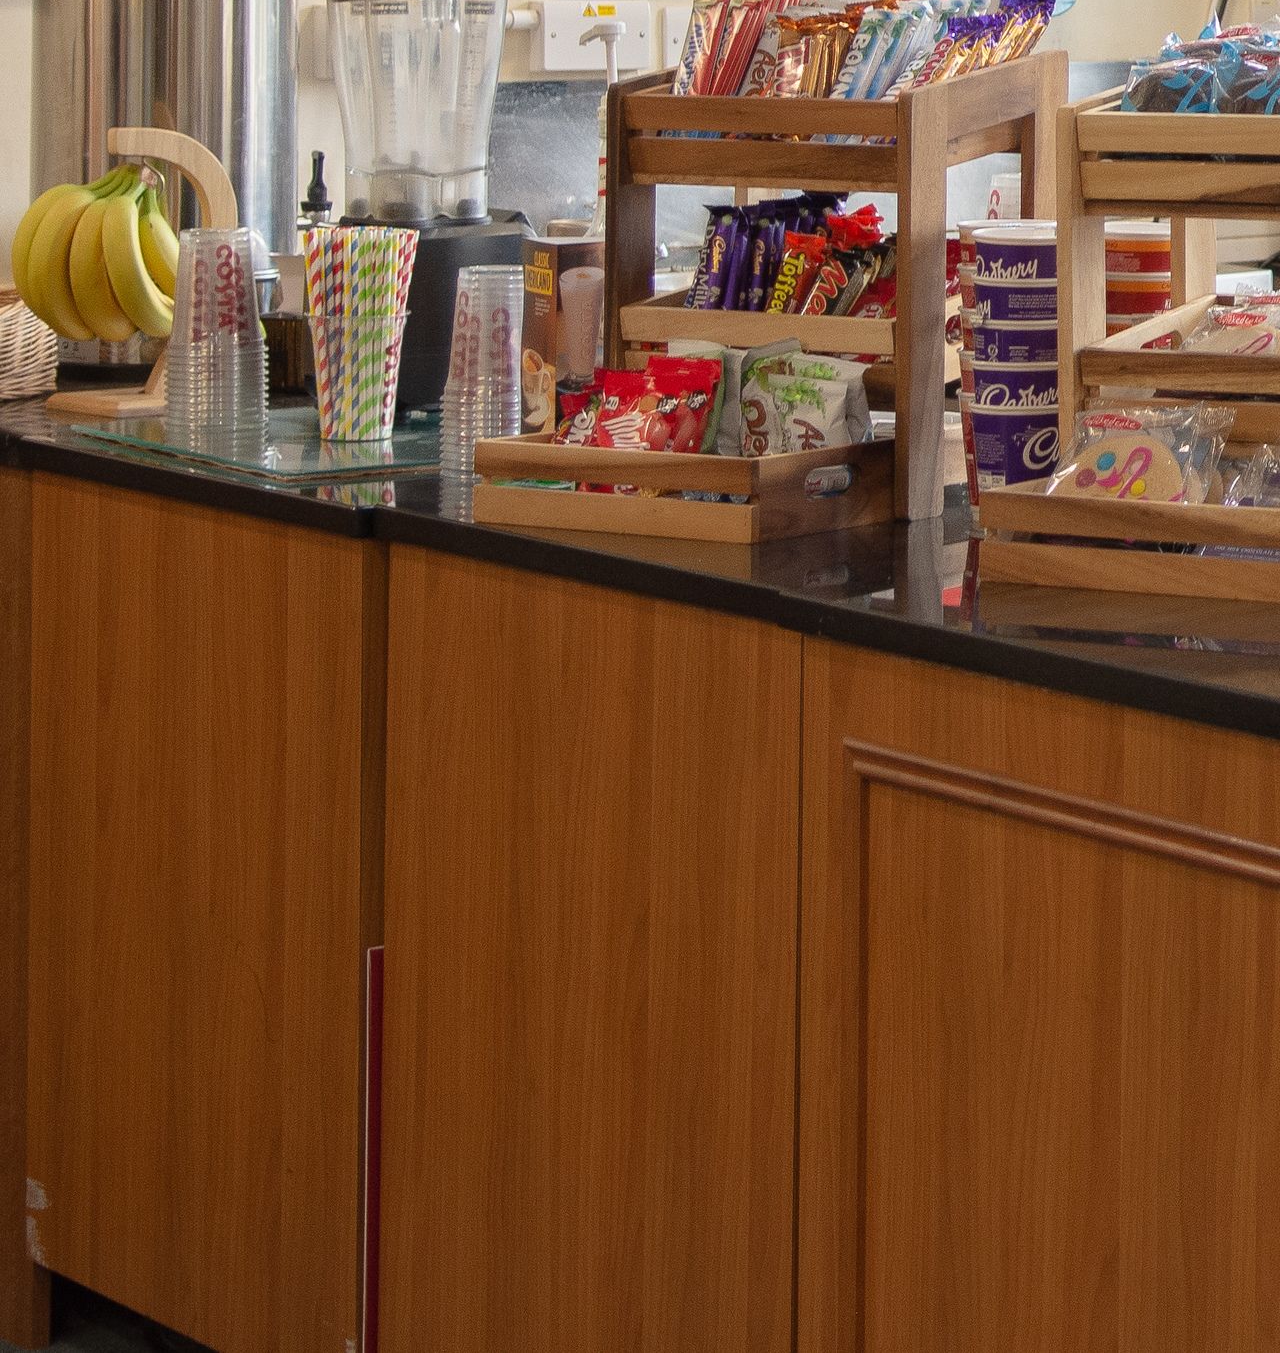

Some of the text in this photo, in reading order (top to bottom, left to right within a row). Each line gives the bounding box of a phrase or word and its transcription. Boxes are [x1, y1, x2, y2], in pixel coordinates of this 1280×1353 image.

[680, 23, 702, 95] Milkyba
[830, 34, 871, 99] BOUN
[215, 244, 234, 335] COSTA
[695, 274, 711, 309] Milk
[807, 258, 848, 315] Ma
